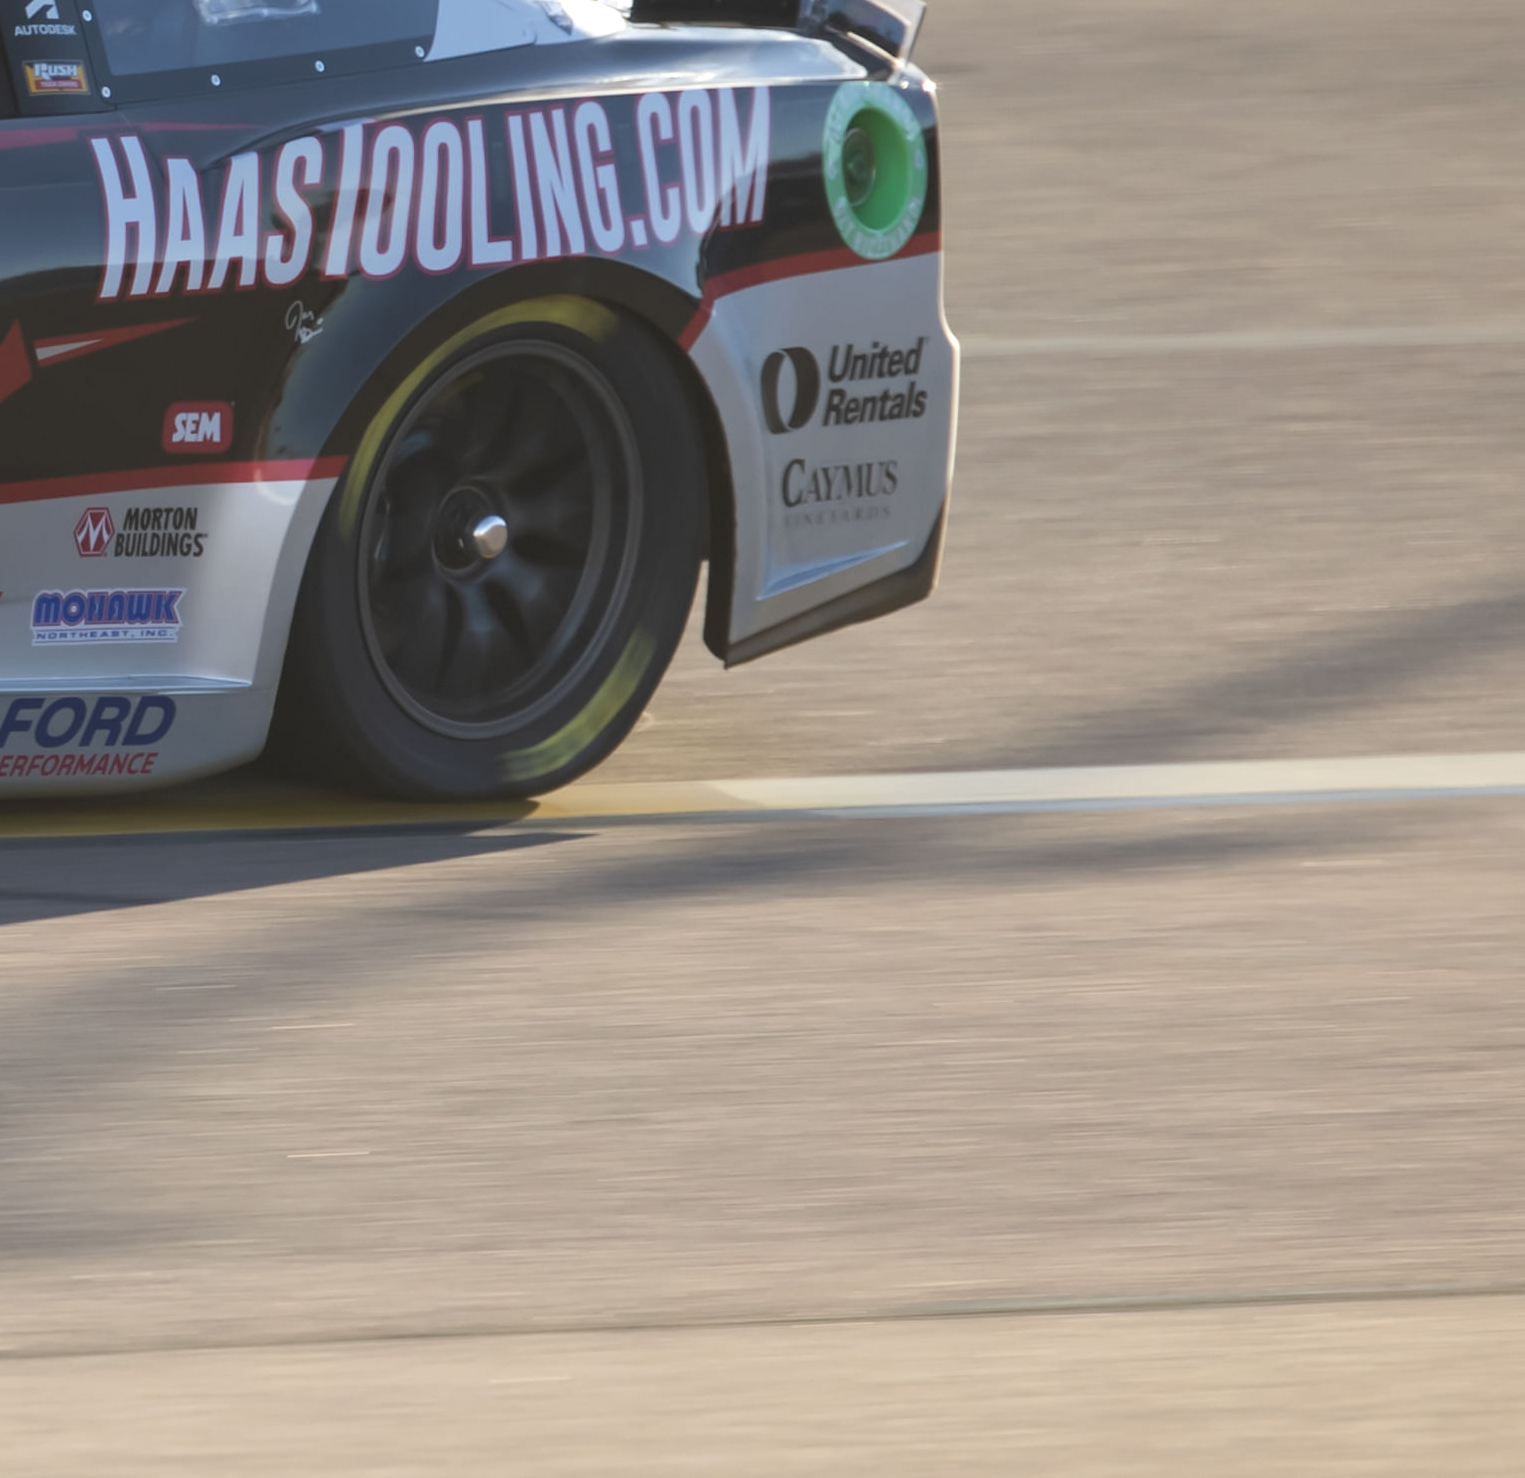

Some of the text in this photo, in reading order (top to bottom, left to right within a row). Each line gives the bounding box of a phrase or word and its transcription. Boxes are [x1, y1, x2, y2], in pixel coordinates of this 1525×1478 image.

[14, 24, 78, 36] AUTODESK
[34, 62, 78, 80] RUSH
[827, 336, 926, 383] United
[822, 382, 928, 427] Rentals
[171, 411, 222, 443] SEM
[781, 458, 899, 509] CAYMUS
[123, 506, 198, 531] MORTON
[114, 532, 205, 558] BUILDINGS
[32, 590, 183, 627] MOHAWK
[36, 629, 174, 640] NORTHEAST, INC.
